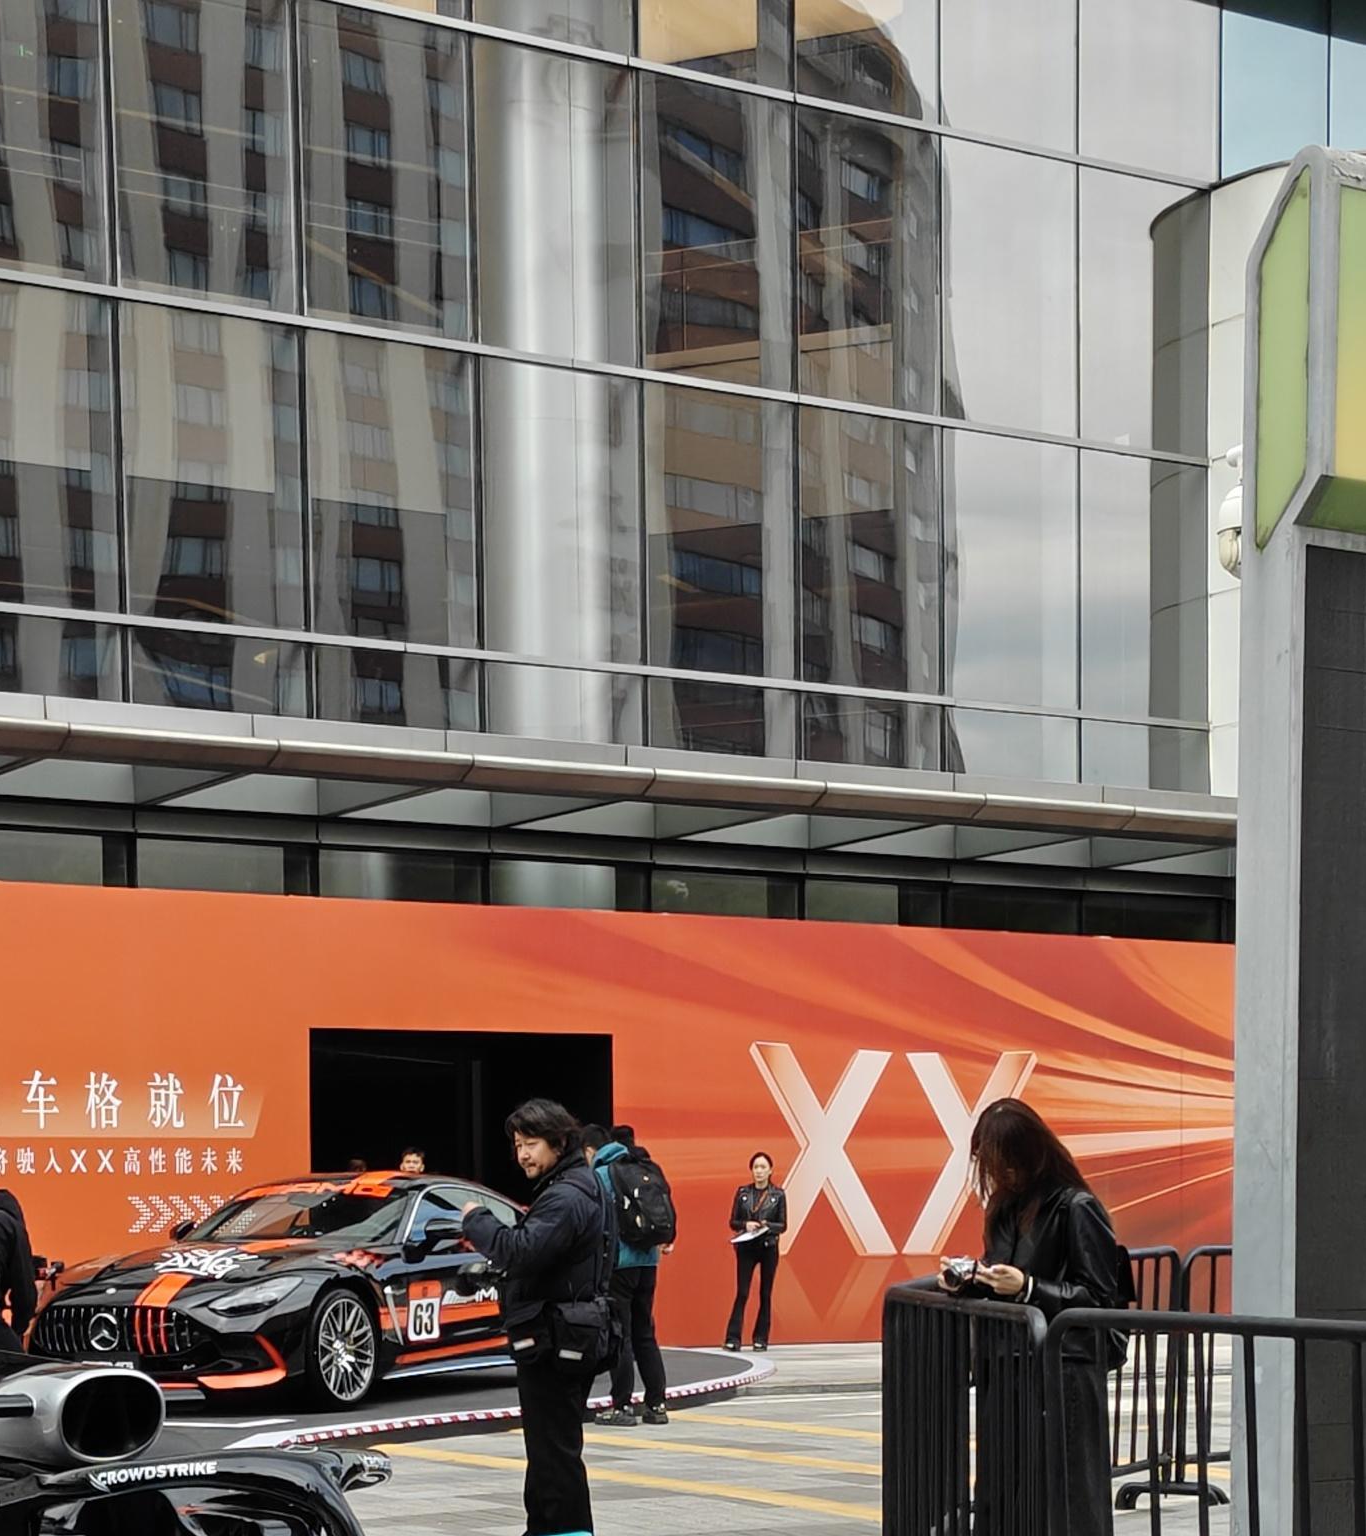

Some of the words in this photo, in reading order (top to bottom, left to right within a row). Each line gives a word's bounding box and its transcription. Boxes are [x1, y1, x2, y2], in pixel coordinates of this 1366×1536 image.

[749, 1040, 1038, 1257] XX
[413, 1302, 435, 1336] 63
[96, 1461, 218, 1487] CROWDSTRIKE
